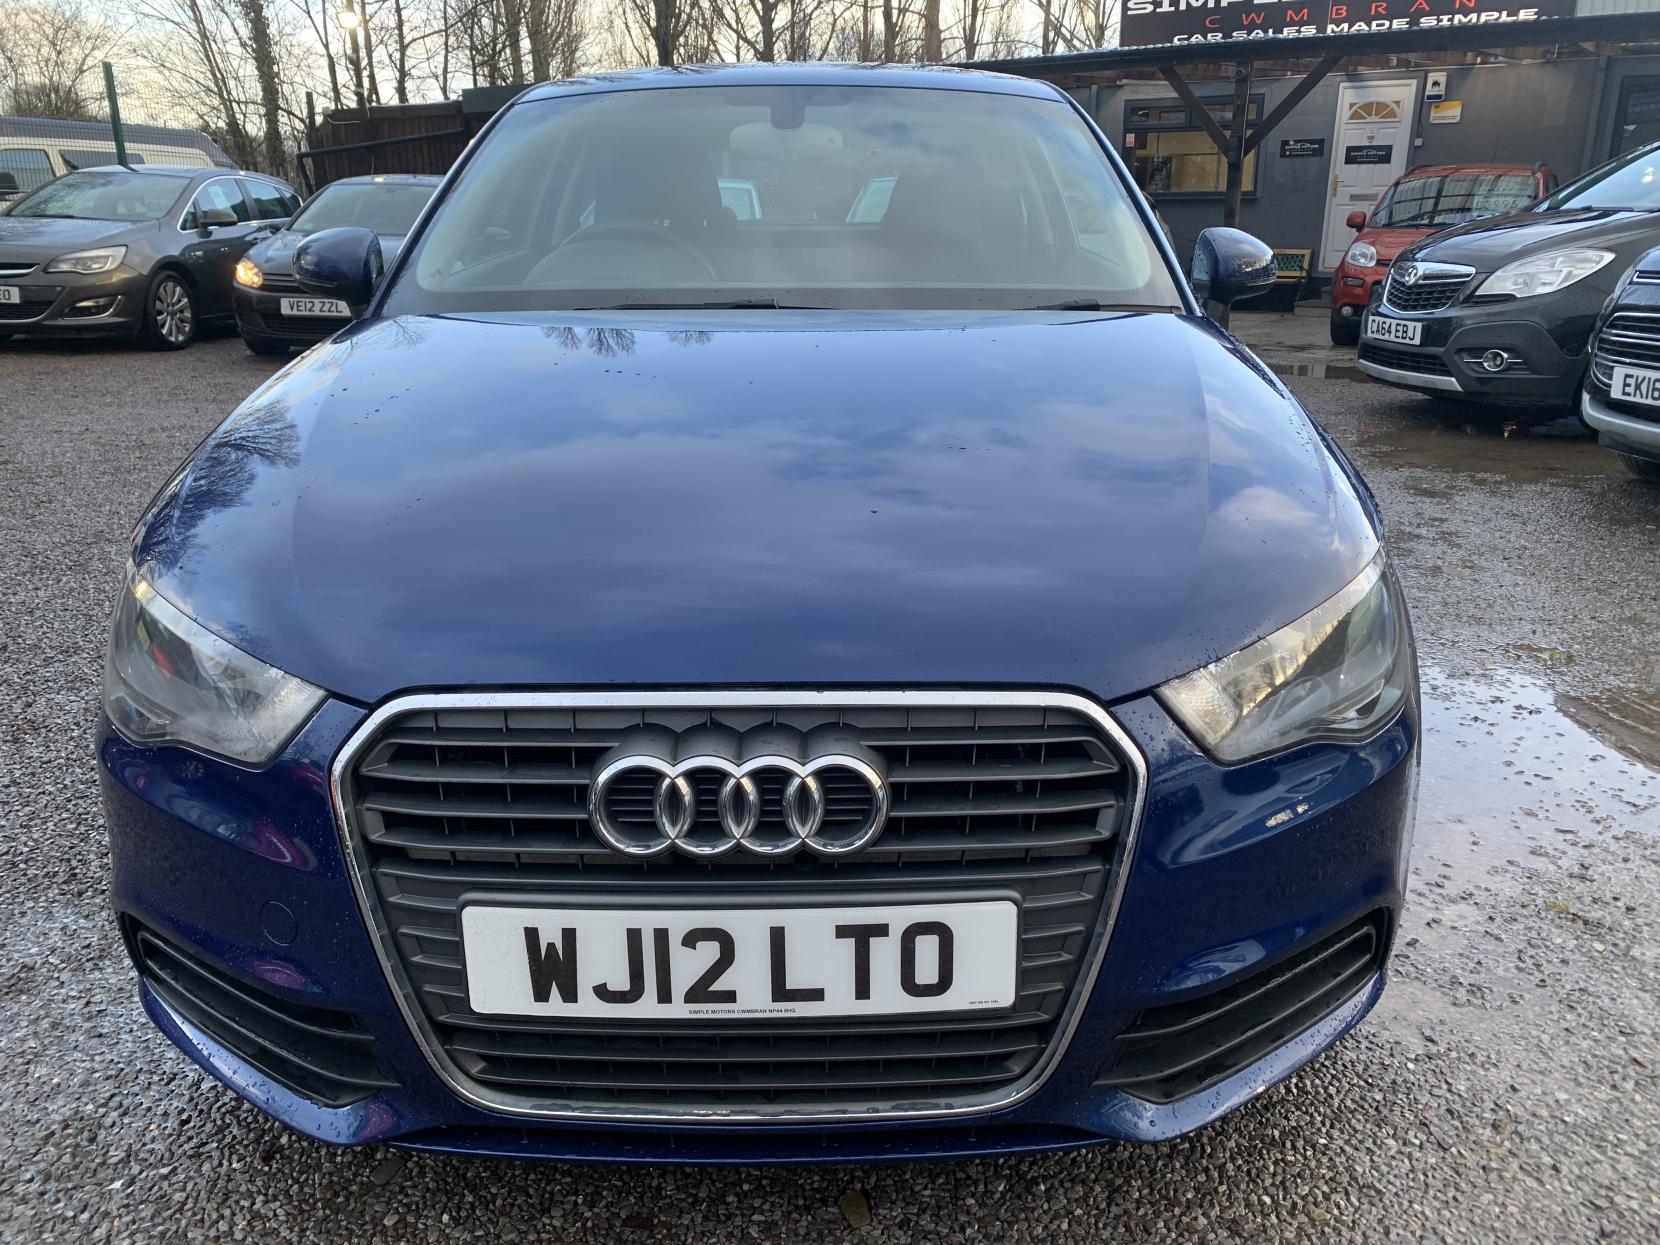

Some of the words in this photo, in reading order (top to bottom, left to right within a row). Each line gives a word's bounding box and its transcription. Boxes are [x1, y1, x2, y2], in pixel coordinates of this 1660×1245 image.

[1127, 0, 1300, 15] SIM
[1173, 33, 1224, 45] CAR
[1232, 25, 1317, 39] SALES
[1327, 18, 1410, 35] MADE
[1420, 8, 1539, 27] SIMPLE
[288, 300, 316, 313] VE12
[319, 301, 344, 314] ZZL
[1370, 319, 1393, 337] CA64
[1395, 323, 1416, 341] EBJ
[1621, 373, 1660, 402] EK16
[523, 926, 738, 1005] WJ12
[769, 920, 955, 1002] LTO
